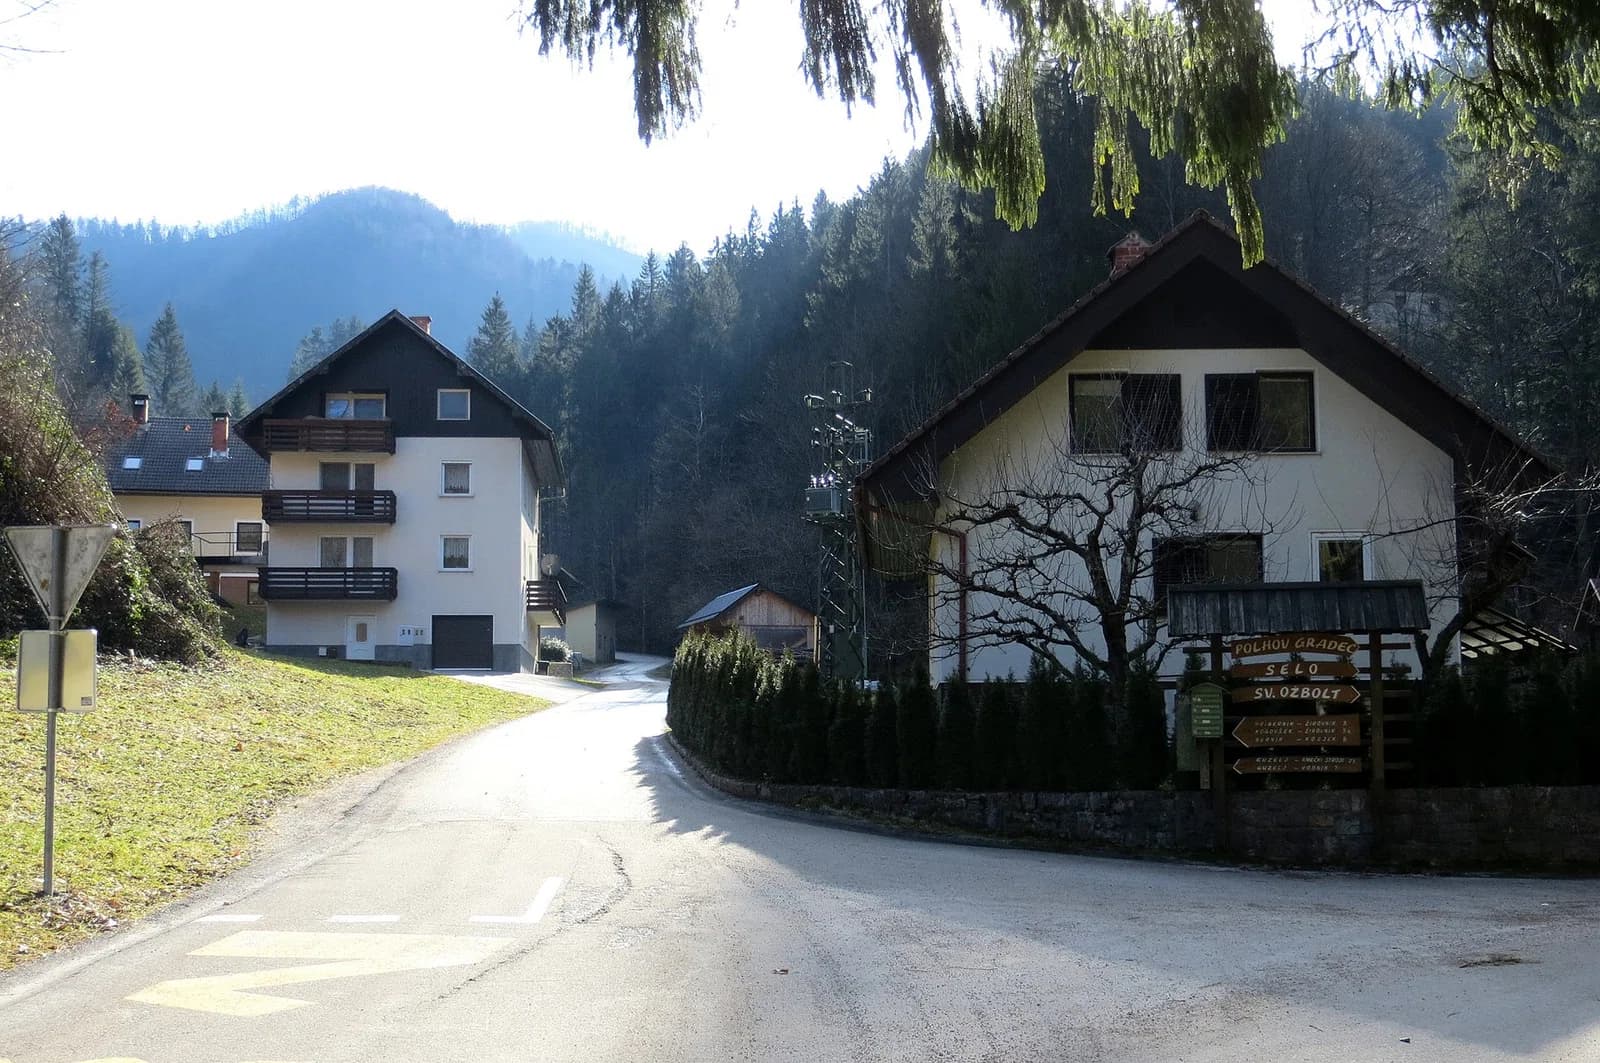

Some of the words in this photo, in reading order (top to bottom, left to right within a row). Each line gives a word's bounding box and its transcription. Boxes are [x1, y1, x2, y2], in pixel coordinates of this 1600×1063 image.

[1235, 638, 1290, 655] POLHOV
[1294, 637, 1357, 653] GRADEC
[1265, 663, 1318, 675] SELO
[1254, 687, 1275, 699] SV.
[1280, 685, 1341, 700] OŽBOLT
